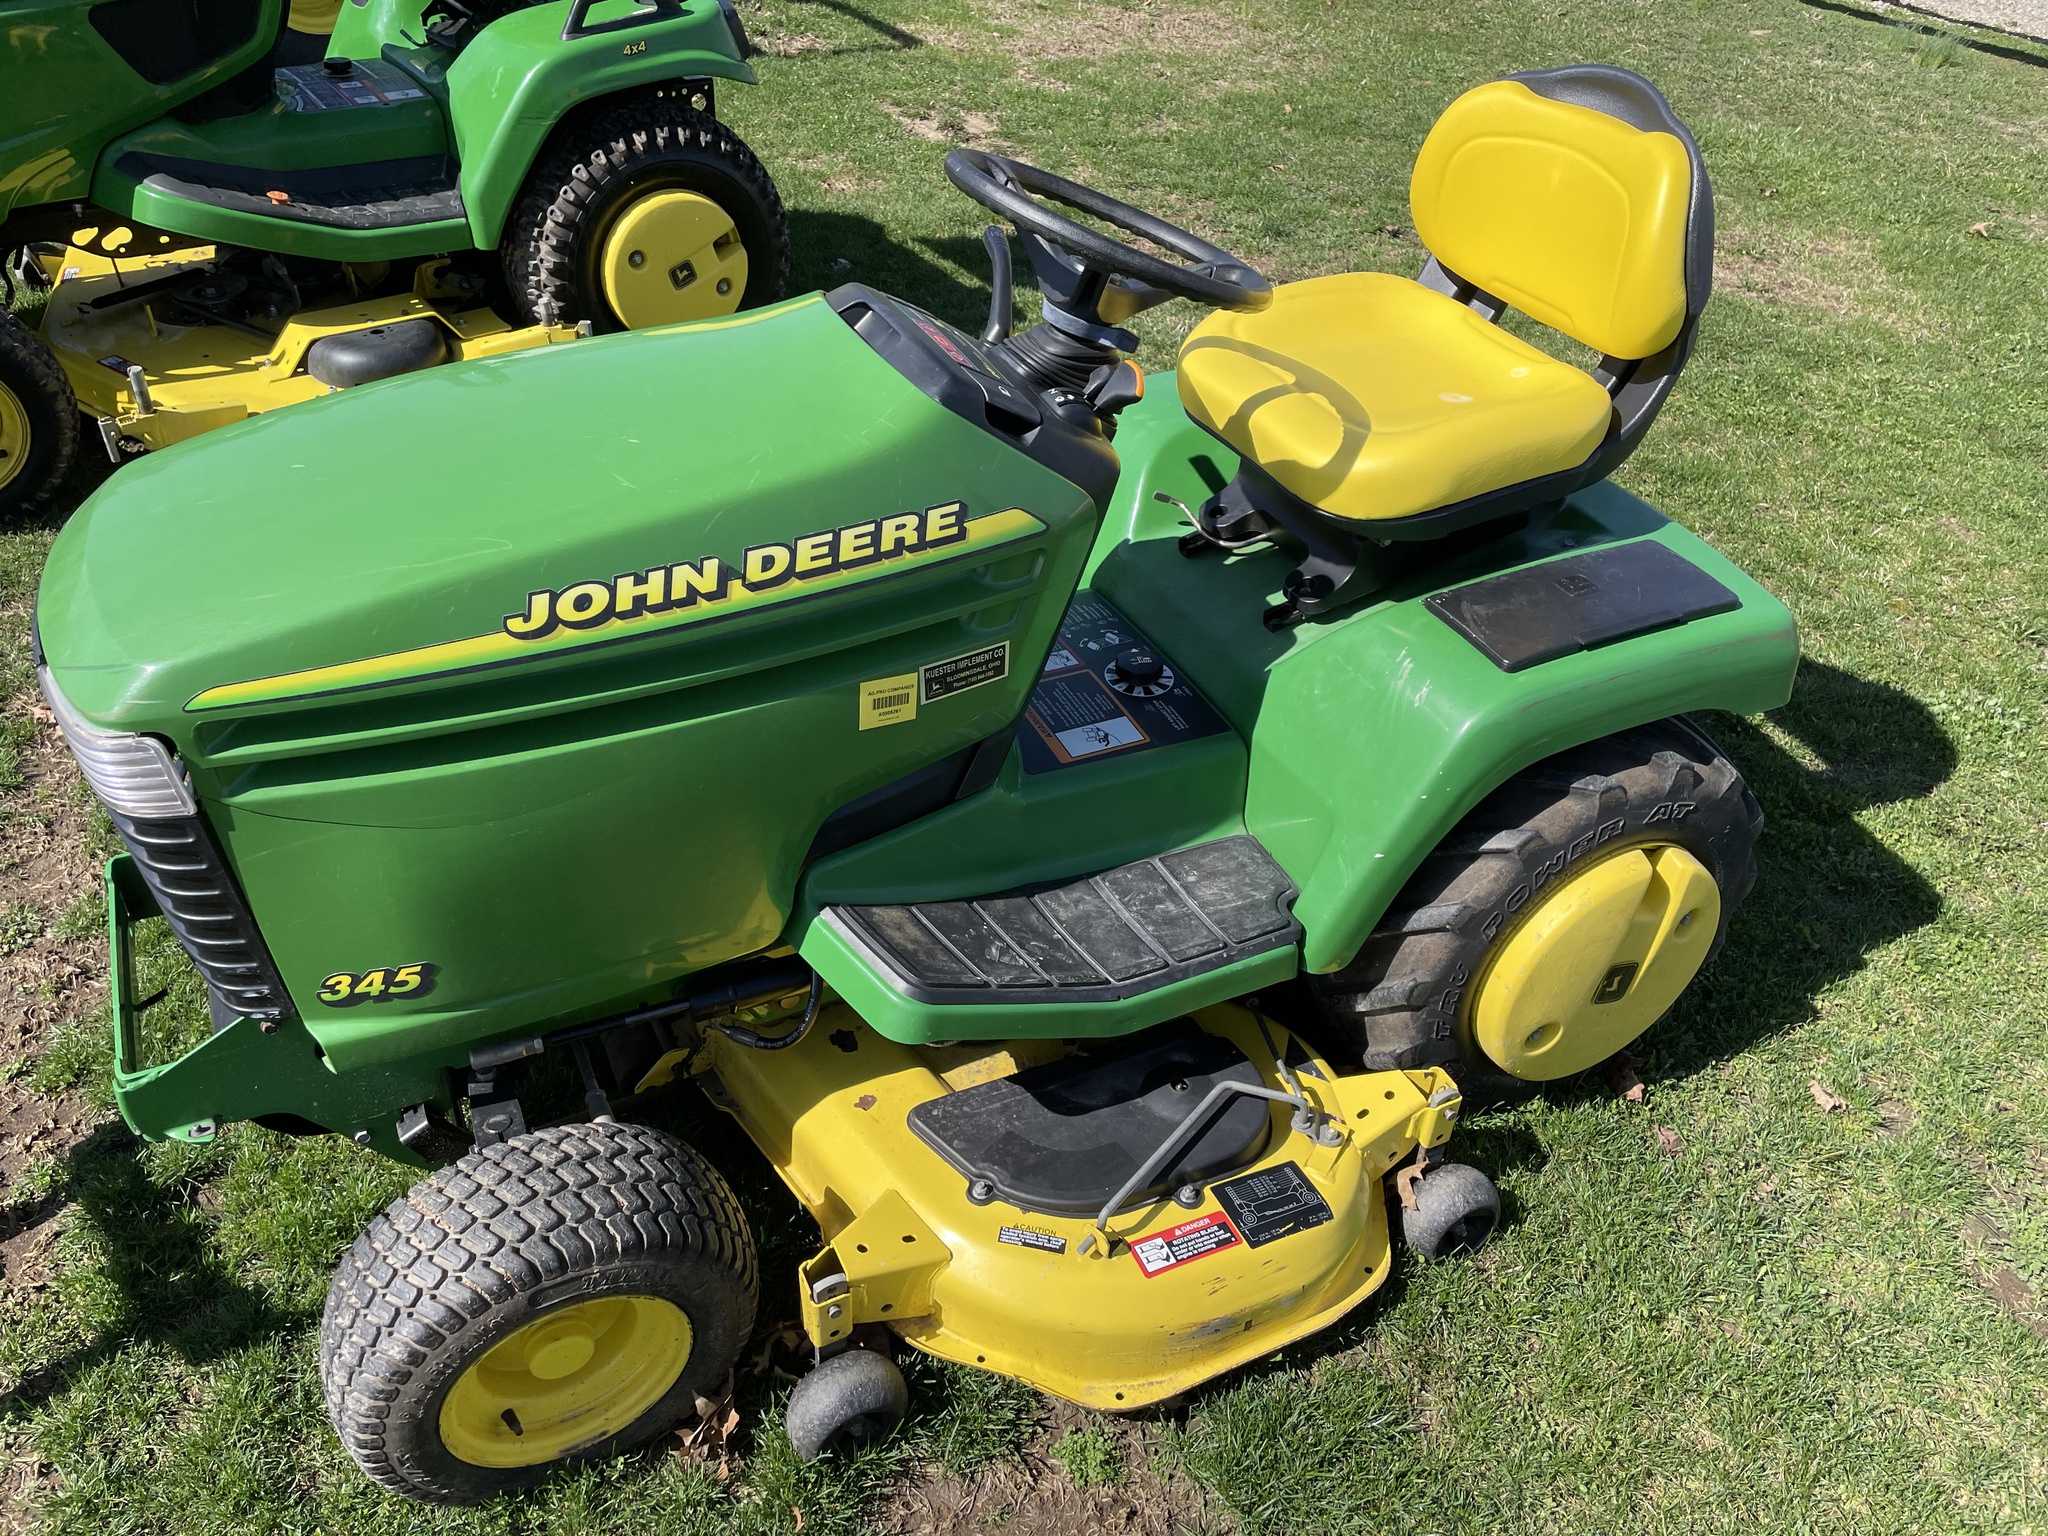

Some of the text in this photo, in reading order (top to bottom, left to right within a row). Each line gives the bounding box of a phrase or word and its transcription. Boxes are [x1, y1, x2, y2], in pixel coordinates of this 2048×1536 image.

[622, 40, 647, 55] 4x4
[505, 502, 963, 634] JOHN DEERE
[925, 648, 1005, 680] KUESTER IMPLEMENT CO.
[988, 660, 1001, 668] OHIO
[887, 684, 914, 693] COMPANIES
[1432, 961, 1470, 1041] TRU
[1480, 816, 1626, 944] POWER
[1642, 801, 1698, 826] AT
[318, 963, 428, 1003] 345
[1020, 1224, 1057, 1236] CAUTION
[1180, 1218, 1211, 1232] DANGER
[1172, 1226, 1219, 1245] ROTATING BLADE
[1196, 1234, 1210, 1243] hands
[1174, 1248, 1188, 1256] under
[1204, 1237, 1218, 1245] mower
[1177, 1251, 1193, 1260] engine
[1198, 1243, 1216, 1252] running
